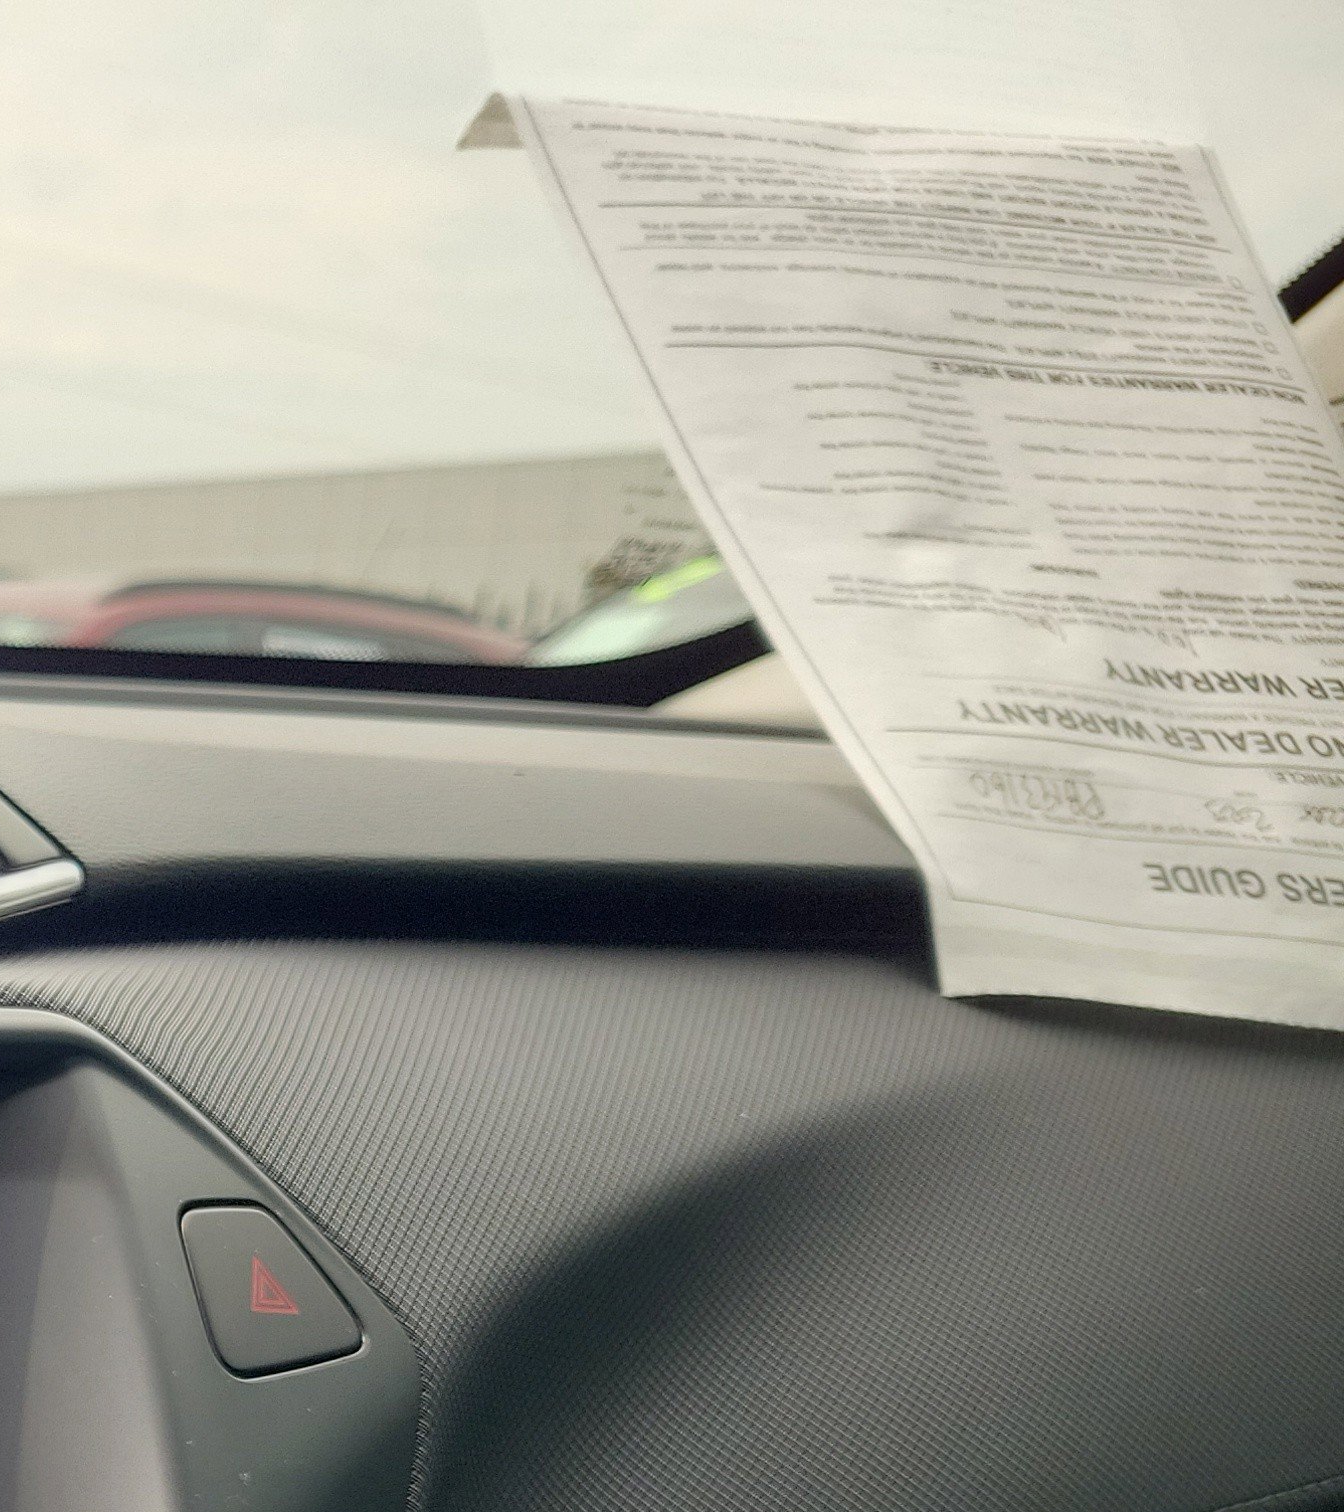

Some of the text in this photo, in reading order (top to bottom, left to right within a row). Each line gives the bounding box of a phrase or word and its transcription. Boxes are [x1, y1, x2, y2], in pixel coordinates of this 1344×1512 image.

[1102, 657, 1297, 698] WARRANTY
[957, 699, 1156, 742] WARRANTY
[1156, 722, 1303, 756] DEALER
[1143, 862, 1267, 899] GUIDE
